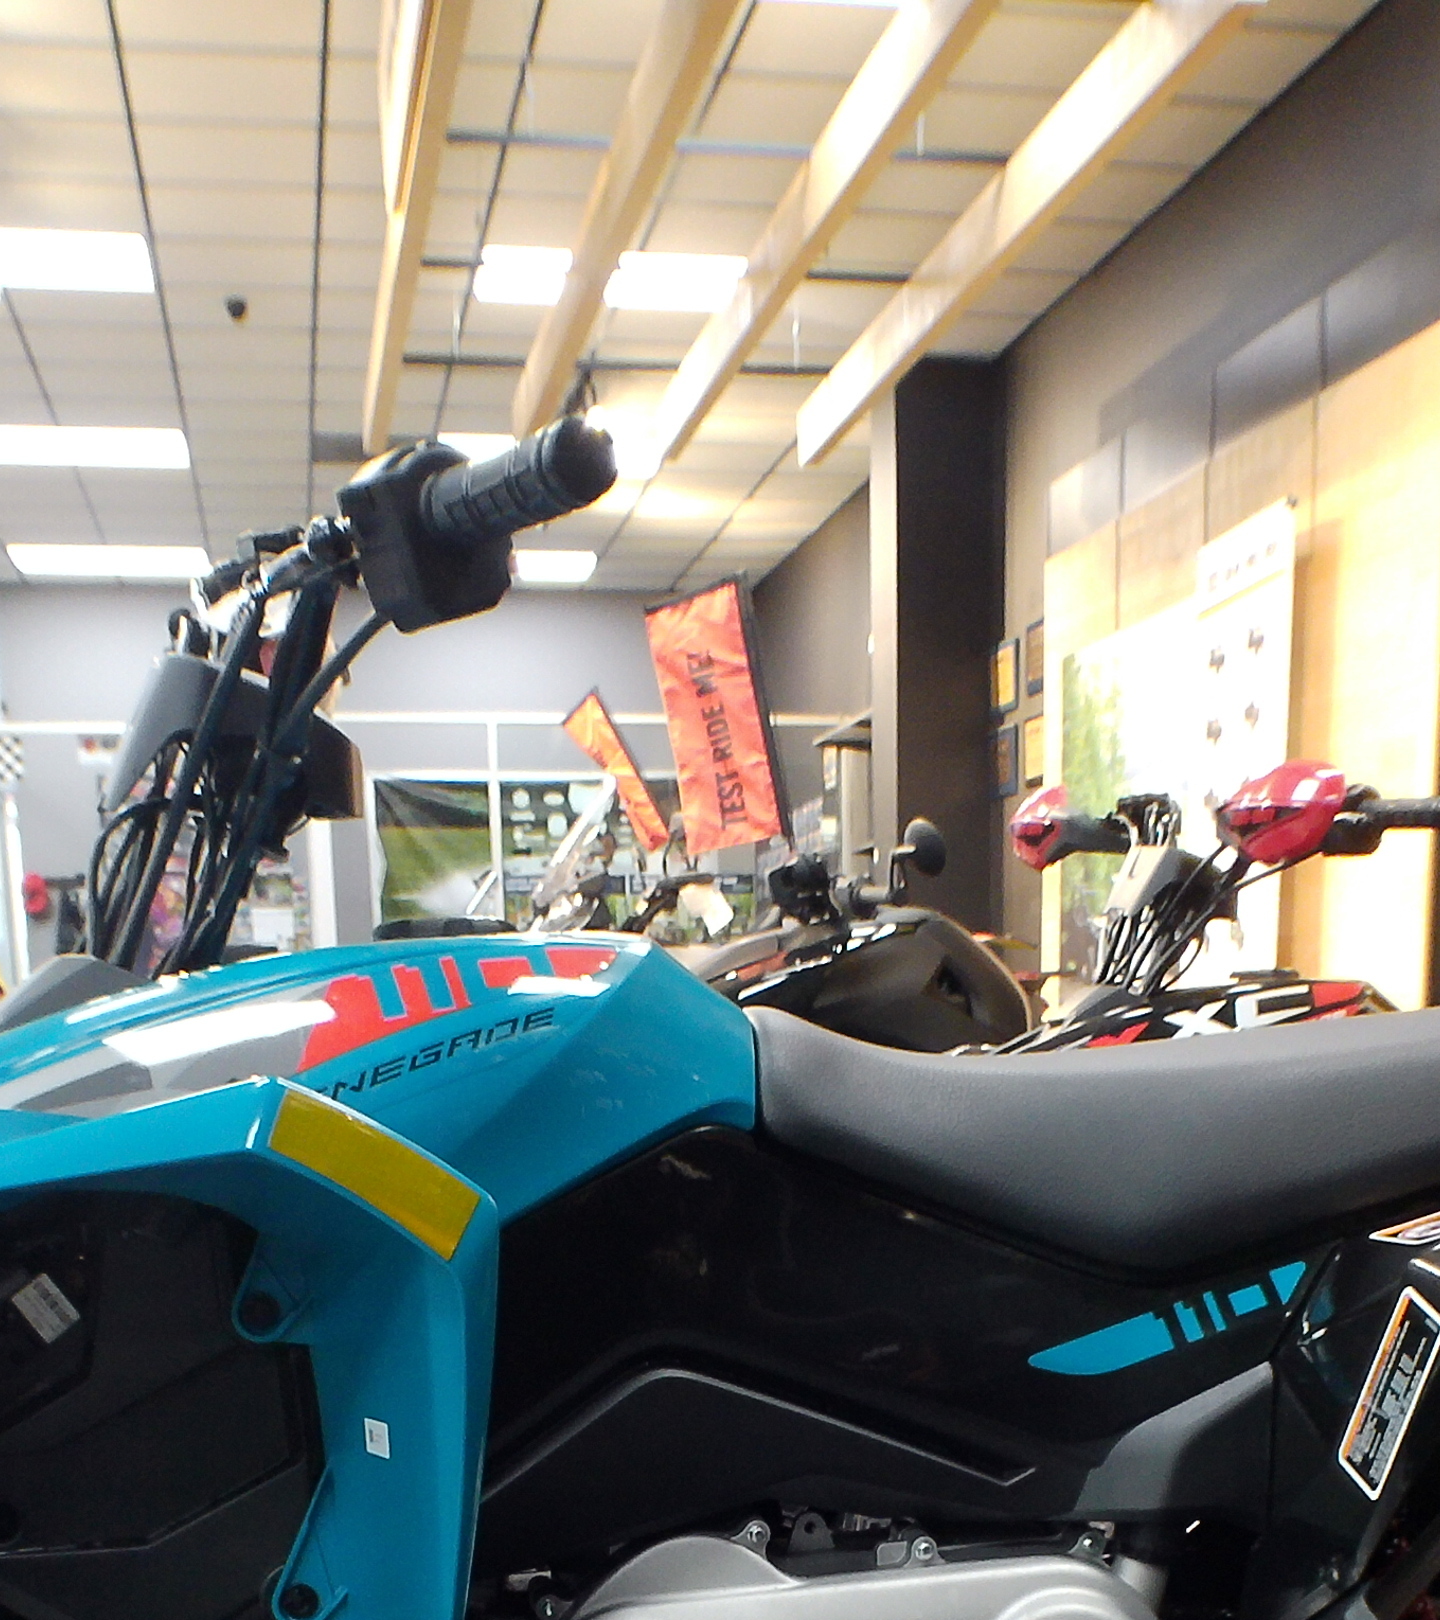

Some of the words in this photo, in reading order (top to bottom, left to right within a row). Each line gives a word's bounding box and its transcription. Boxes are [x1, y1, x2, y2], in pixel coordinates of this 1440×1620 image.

[701, 701, 734, 762] RIDE
[715, 769, 747, 830] TEST
[317, 1006, 556, 1101] NEGADE
